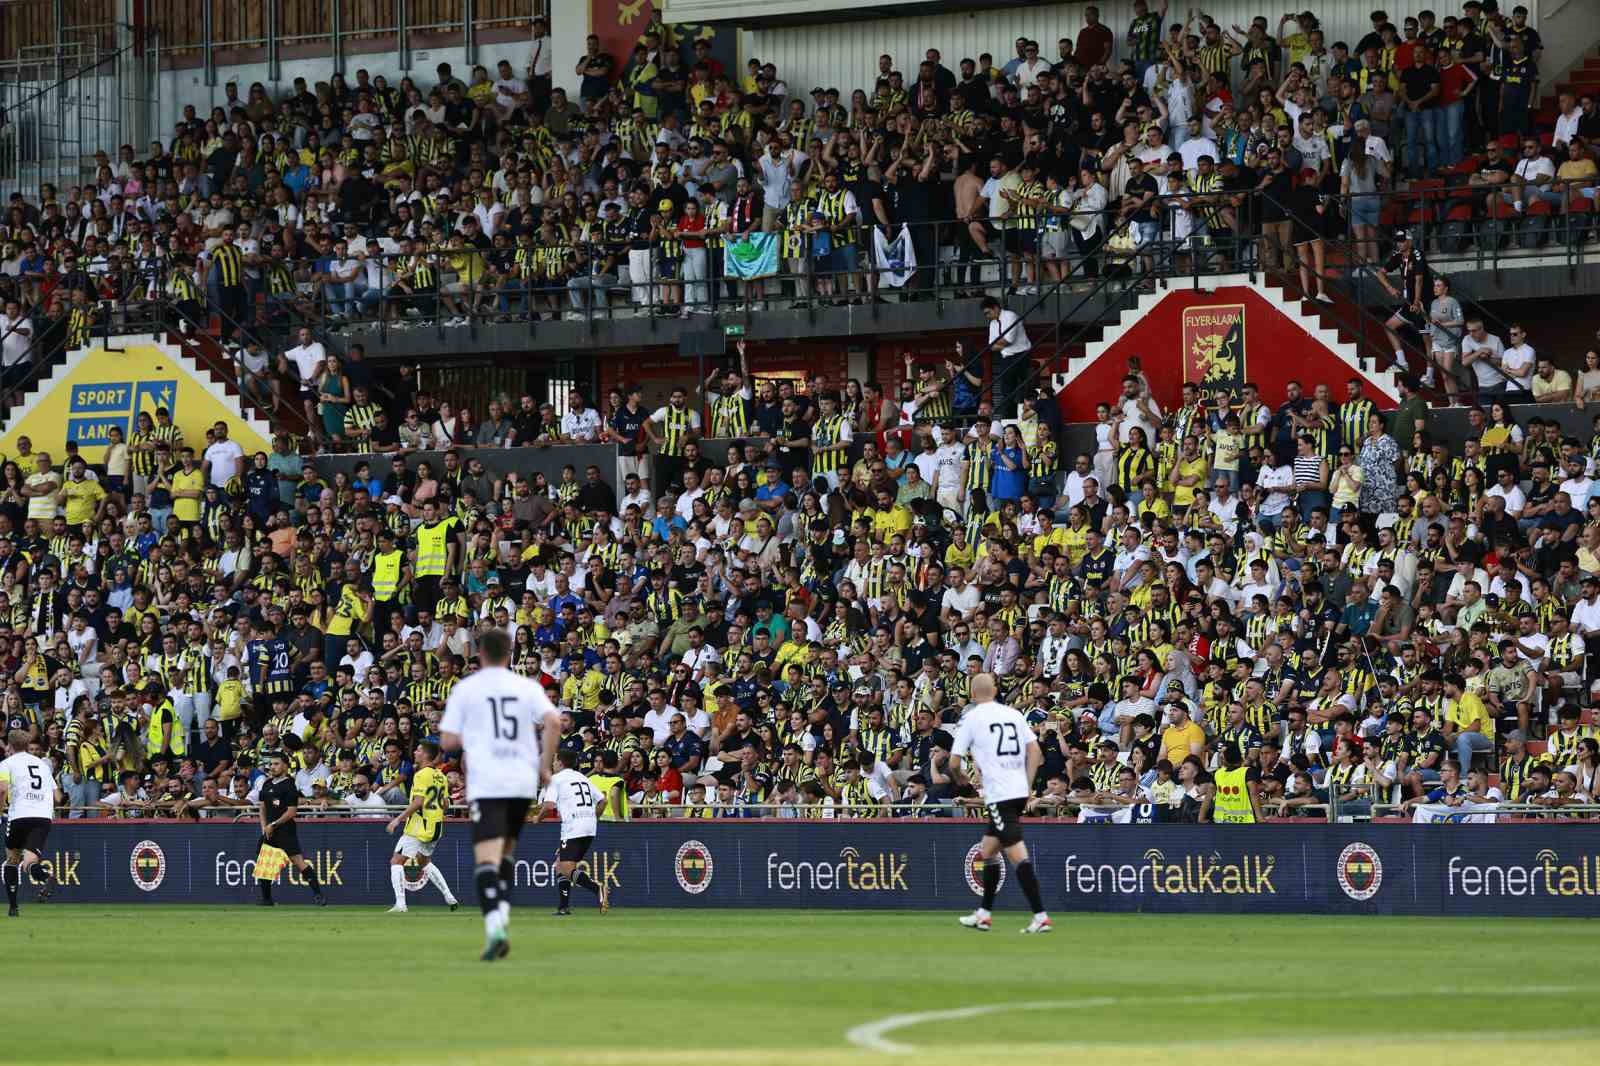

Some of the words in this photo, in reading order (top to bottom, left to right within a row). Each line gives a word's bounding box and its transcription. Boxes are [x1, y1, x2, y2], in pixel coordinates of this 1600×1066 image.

[1186, 314, 1242, 327] FLYERALARM
[77, 389, 126, 406] SPORT
[273, 652, 289, 669] 10
[487, 696, 519, 741] 15
[989, 722, 1021, 757] 23
[27, 765, 42, 790] 5
[571, 781, 593, 807] 33
[767, 852, 908, 890] fenertalk
